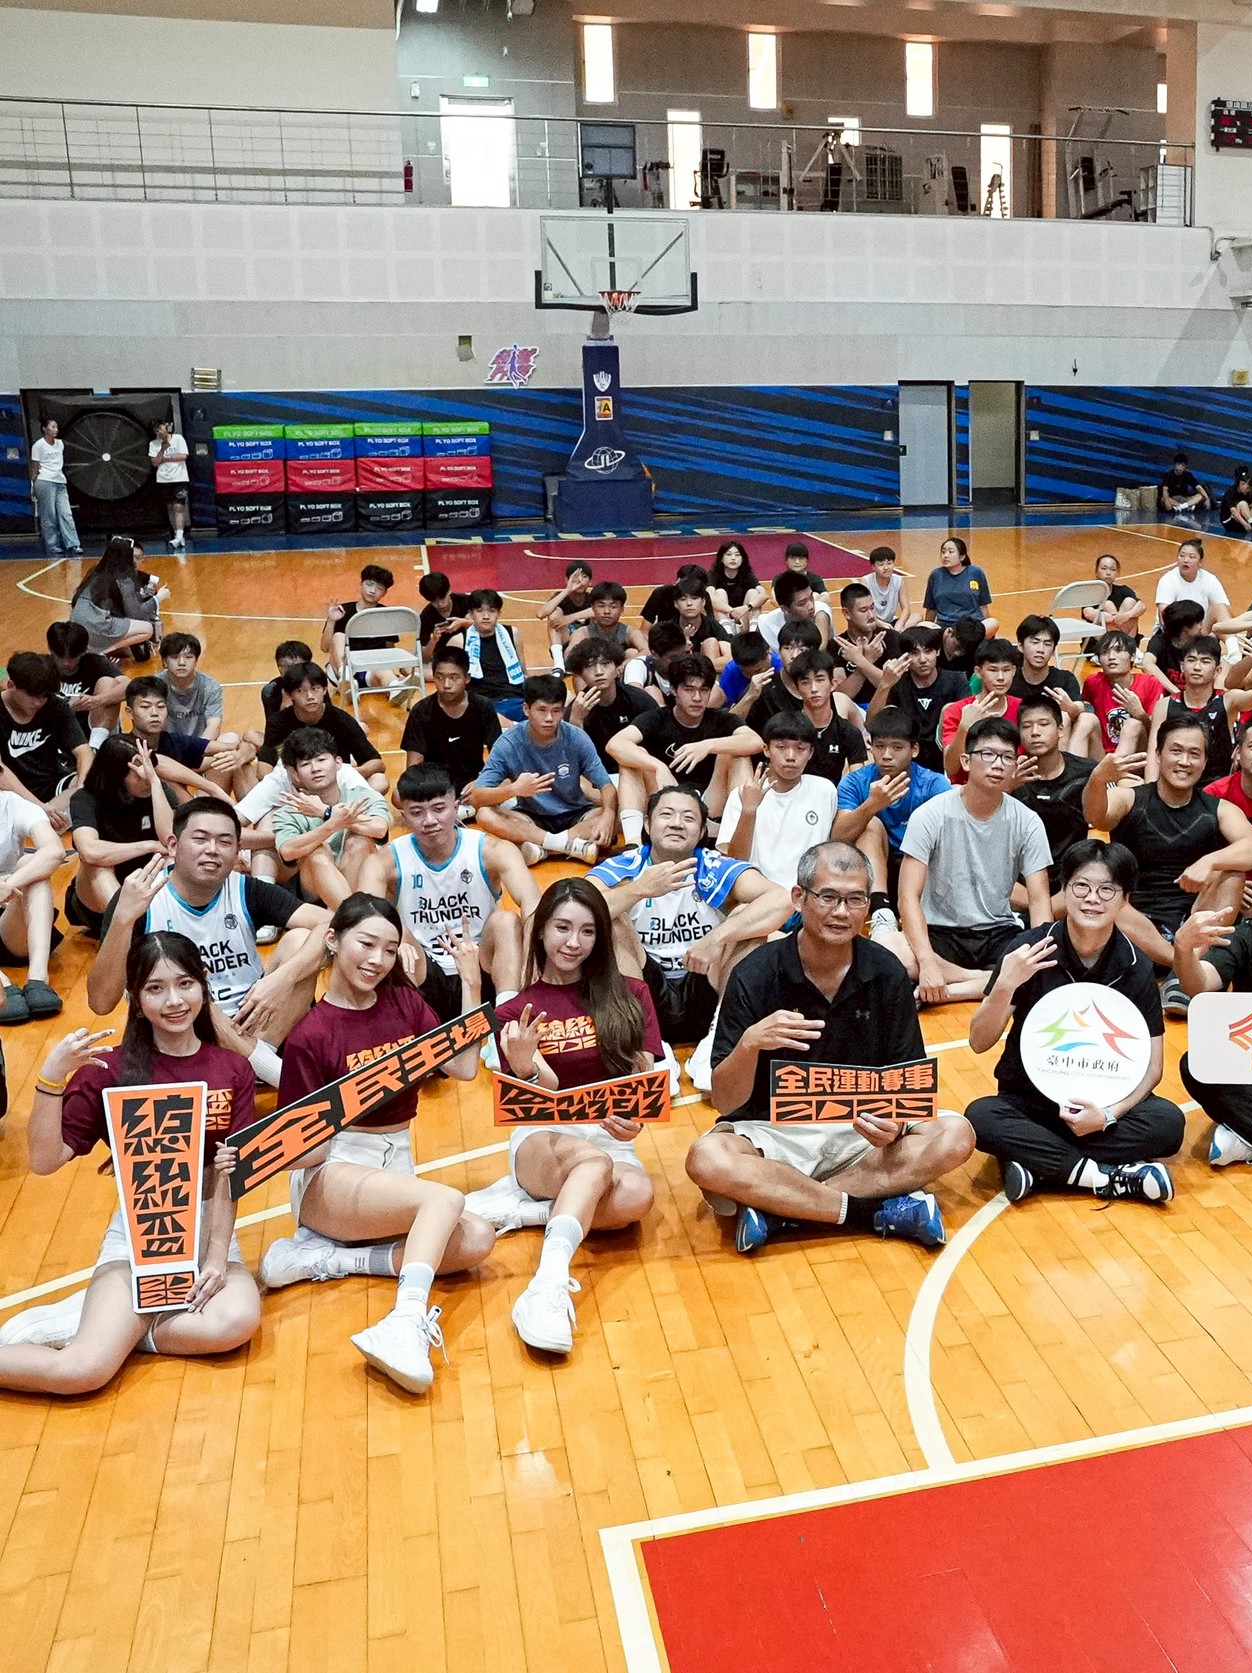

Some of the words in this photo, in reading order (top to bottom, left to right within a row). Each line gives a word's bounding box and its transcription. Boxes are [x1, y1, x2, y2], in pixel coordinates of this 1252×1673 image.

[10, 728, 43, 747] NIKE
[411, 873, 424, 889] 10
[418, 891, 469, 911] BLACK
[410, 905, 483, 925] THUNDER
[650, 911, 700, 931] BLACK
[200, 939, 234, 959] ACK
[203, 952, 253, 974] NDER
[1046, 1054, 1121, 1073] 臺中市政府
[775, 1063, 935, 1095] 全民運動賽事
[239, 1011, 492, 1190] 全民主場
